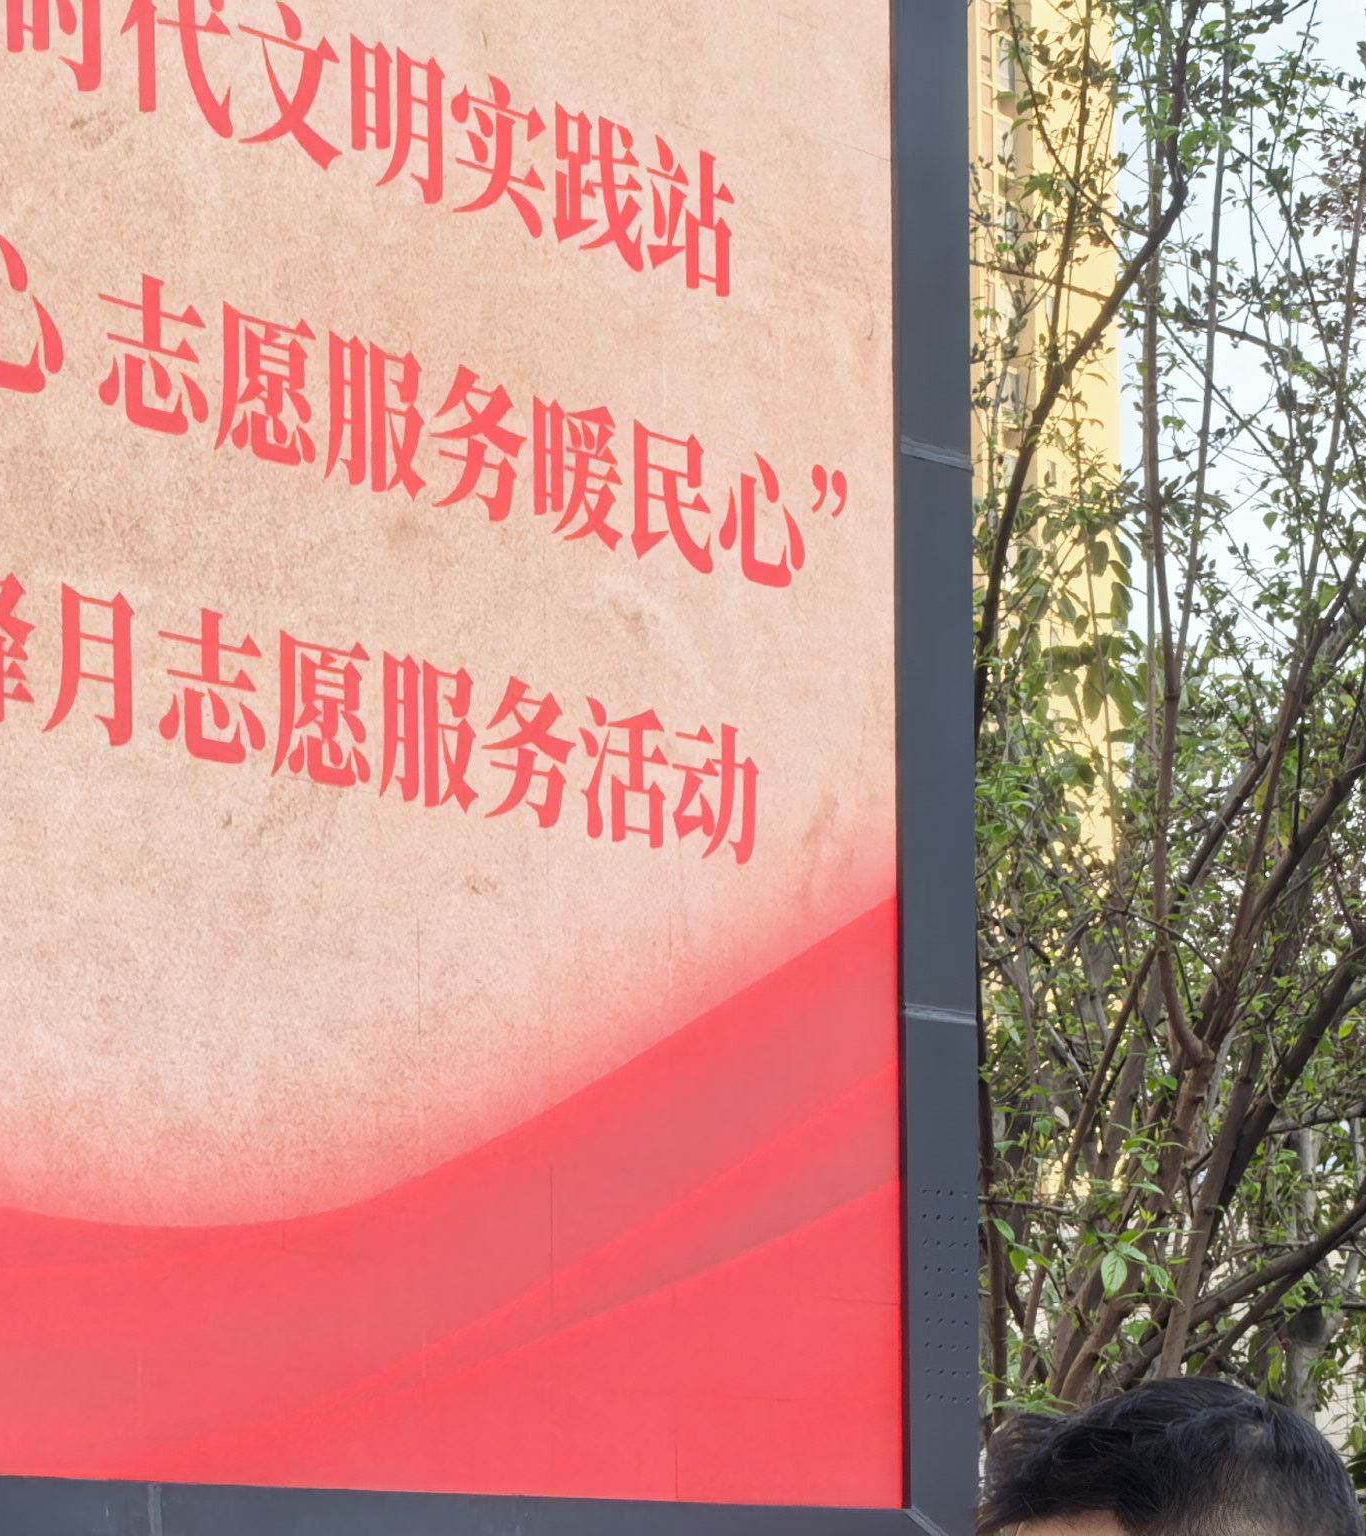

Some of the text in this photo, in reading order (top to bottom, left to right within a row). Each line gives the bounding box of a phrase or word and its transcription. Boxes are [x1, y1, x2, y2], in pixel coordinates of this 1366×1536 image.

[97, 273, 848, 589] 志愿服务暖民心”
